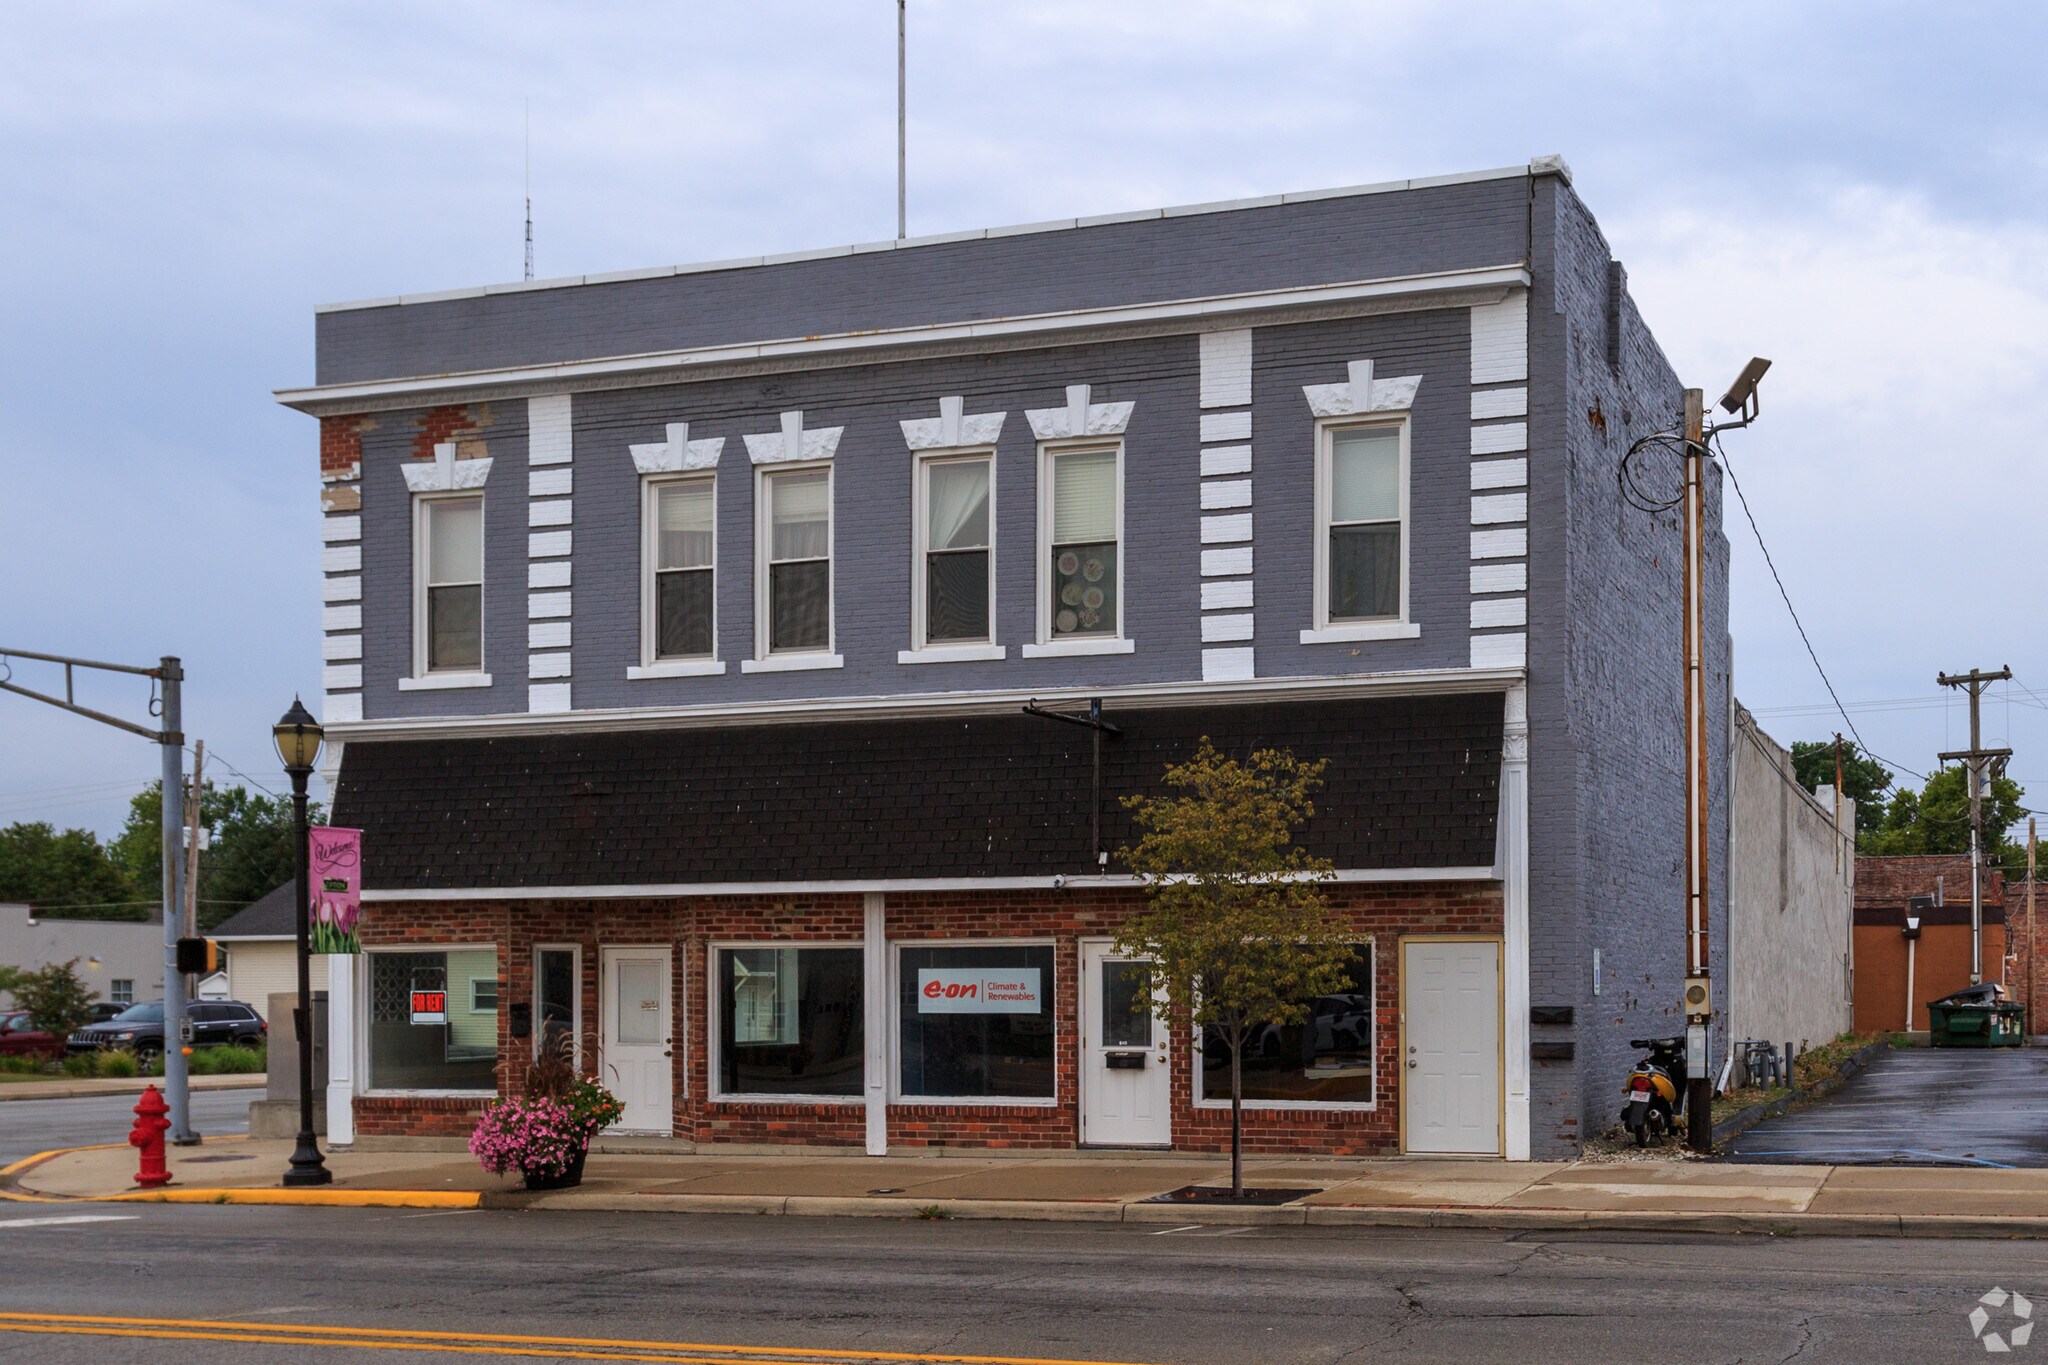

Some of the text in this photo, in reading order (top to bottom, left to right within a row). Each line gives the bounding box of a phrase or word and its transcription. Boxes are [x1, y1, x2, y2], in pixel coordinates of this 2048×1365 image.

[987, 982, 1026, 991] Climate &
[988, 992, 1035, 1001] Renewables
[413, 993, 445, 1011] FOR RENT
